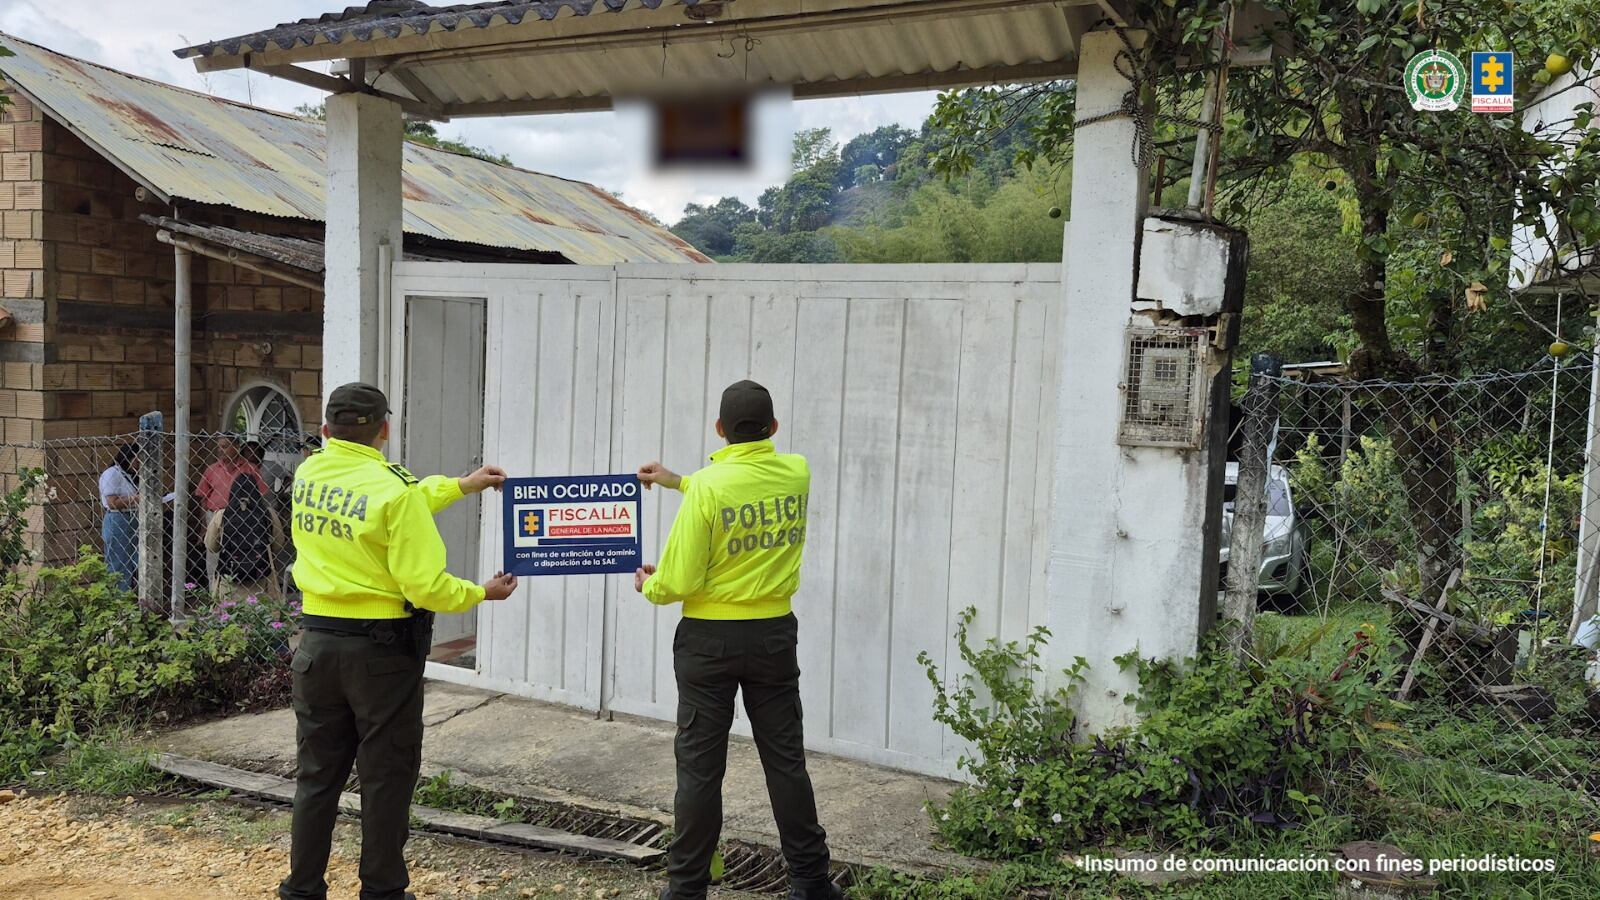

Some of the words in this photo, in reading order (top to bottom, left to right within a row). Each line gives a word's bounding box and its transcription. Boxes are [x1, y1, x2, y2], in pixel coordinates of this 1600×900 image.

[514, 485, 548, 499] BIEN
[553, 482, 636, 498] OCUPADO
[549, 504, 630, 521] FISCALÍA
[295, 511, 353, 541] 18783
[602, 525, 629, 534] NACIÓN
[531, 551, 548, 559] fines
[561, 549, 593, 558] extinción
[594, 549, 605, 557] de
[540, 560, 581, 568] disposición
[602, 558, 618, 566] SAE.
